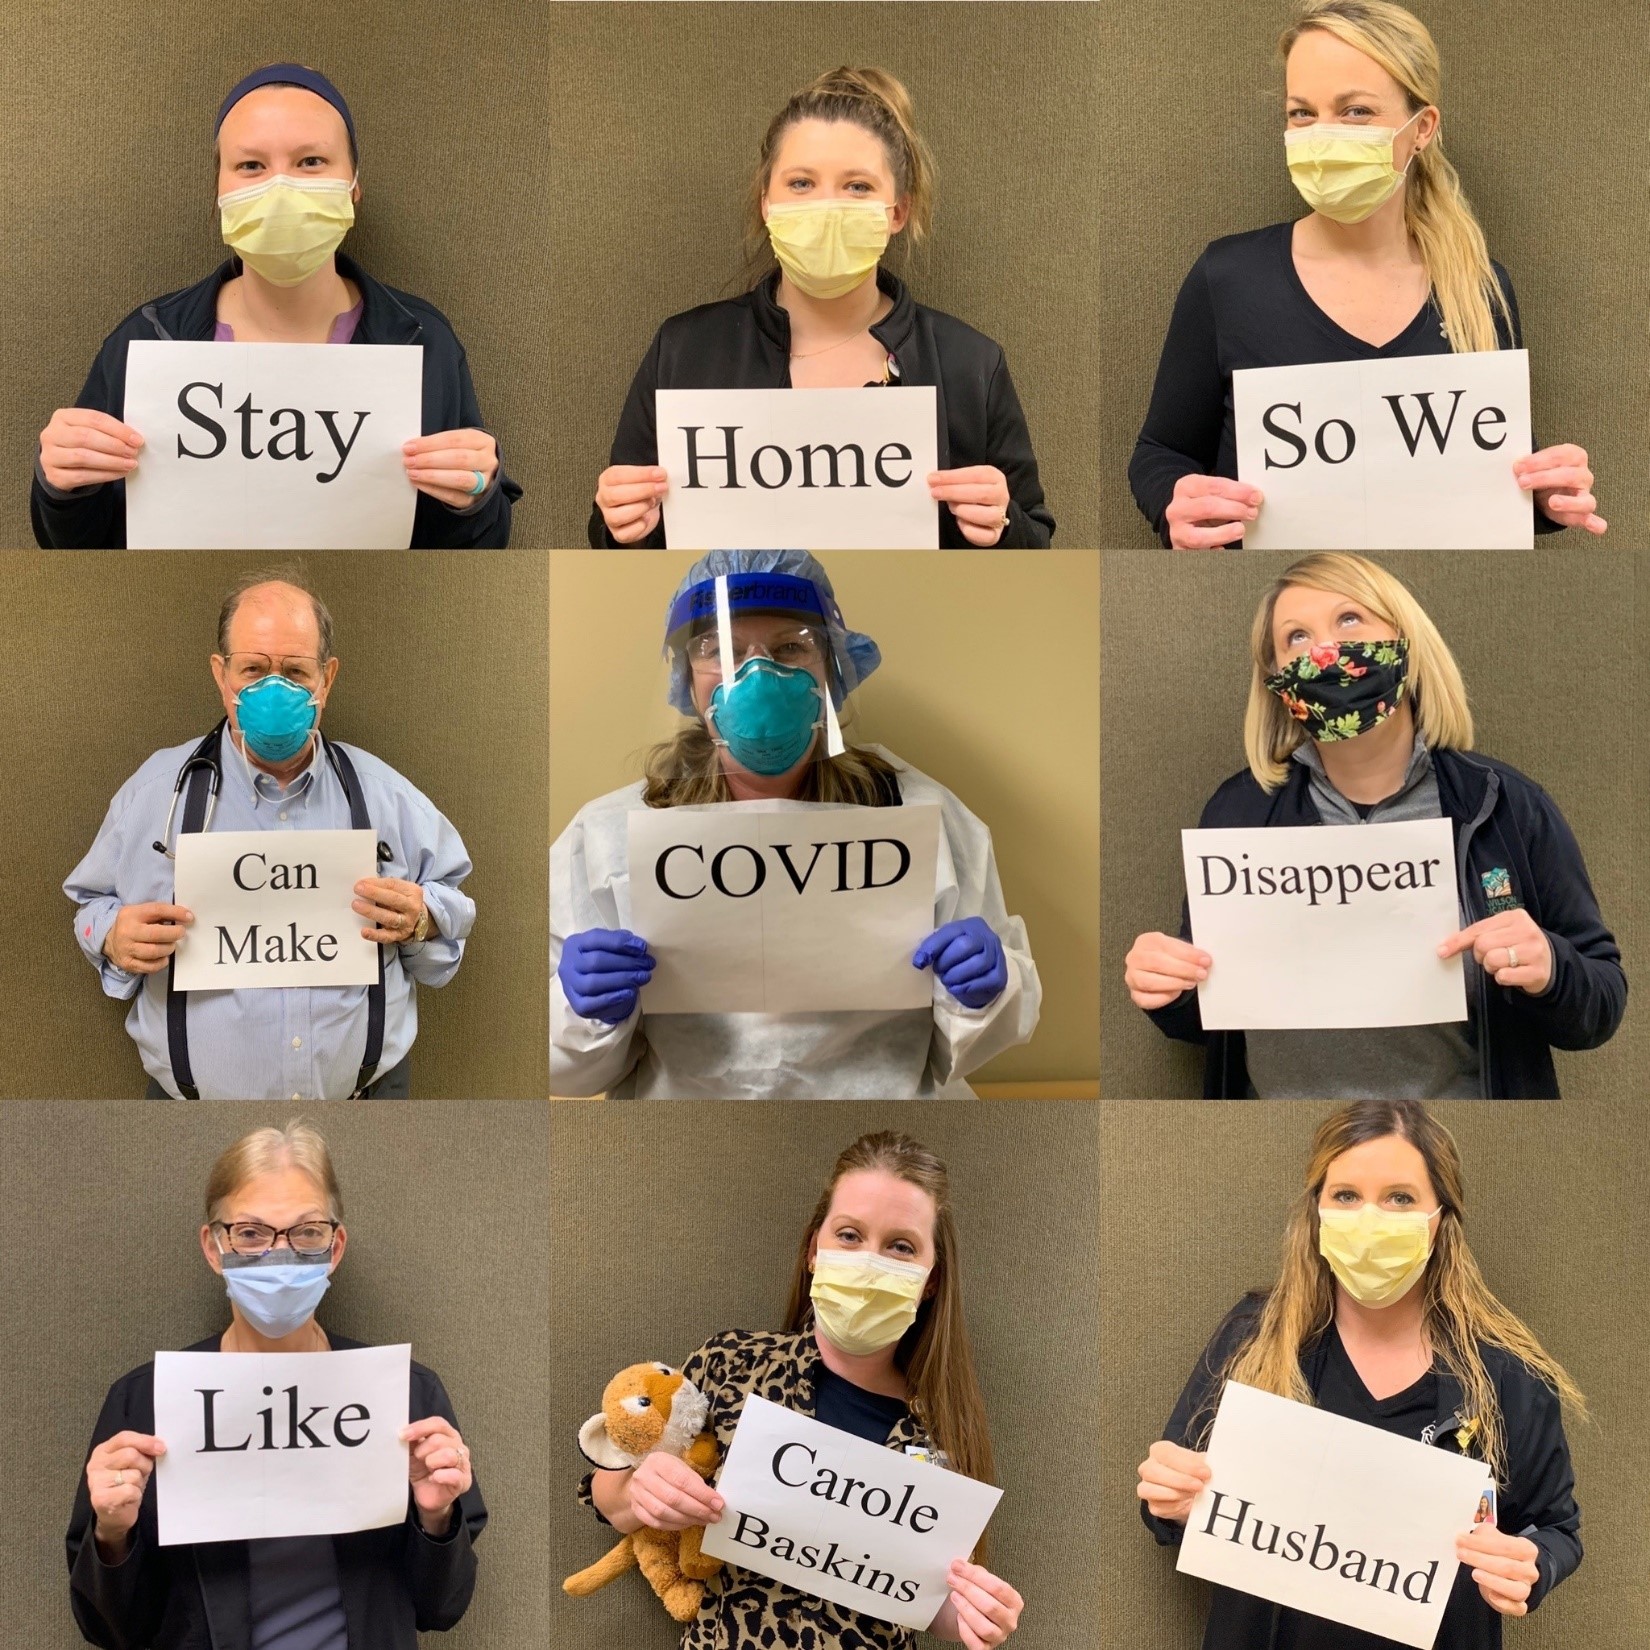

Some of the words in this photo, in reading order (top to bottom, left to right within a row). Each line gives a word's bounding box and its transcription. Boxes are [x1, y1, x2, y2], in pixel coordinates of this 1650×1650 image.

[176, 381, 371, 484] Stay
[677, 425, 913, 489] Home
[1261, 401, 1356, 470] So
[1381, 389, 1507, 458] We
[232, 853, 320, 891] Can
[655, 838, 911, 900] COVID
[1196, 853, 1440, 905] Disappear
[1486, 895, 1518, 907] WILSON
[214, 922, 339, 964] Make
[194, 1385, 371, 1453] Like
[771, 1441, 939, 1534] Carole
[728, 1510, 921, 1603] Baskins
[1199, 1489, 1439, 1604] Husband
